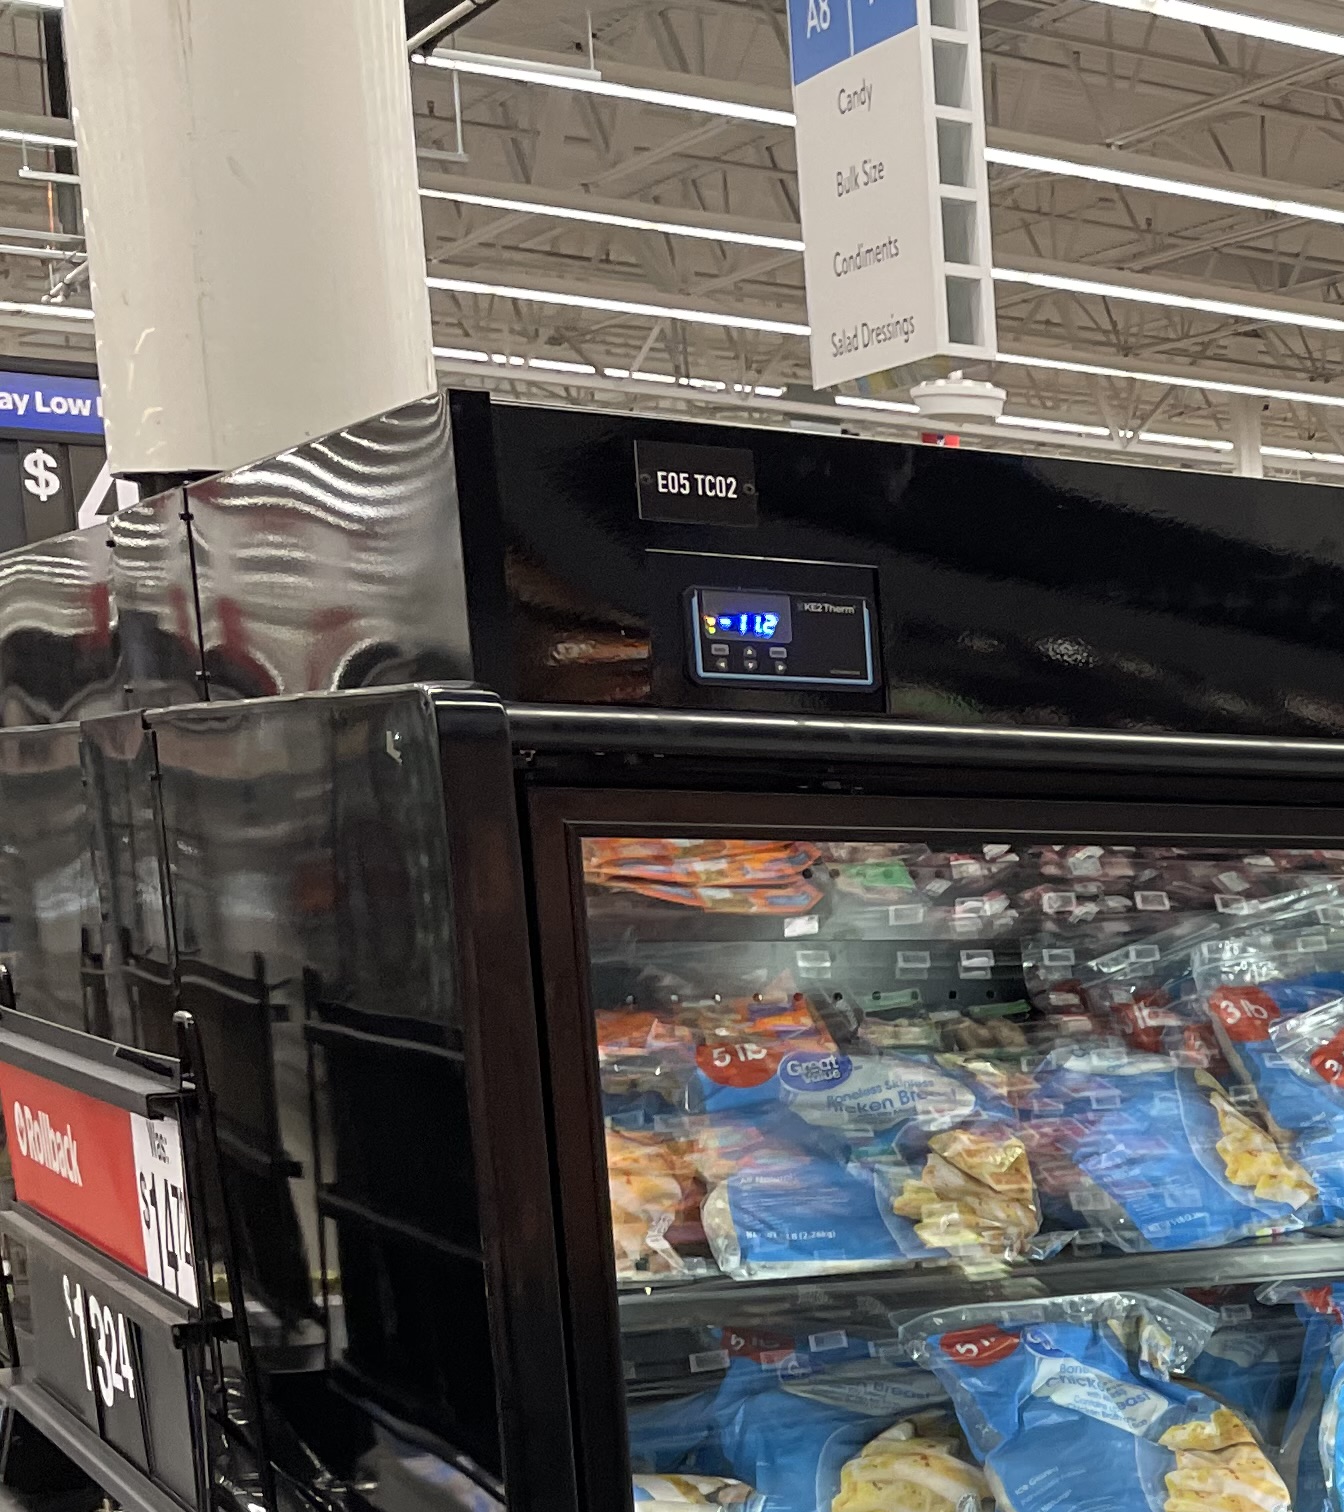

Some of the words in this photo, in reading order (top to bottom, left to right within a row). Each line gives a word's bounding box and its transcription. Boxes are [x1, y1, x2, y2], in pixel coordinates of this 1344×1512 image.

[837, 79, 873, 115] Candy
[836, 164, 860, 198] Bulk
[861, 160, 885, 186] Size
[833, 236, 900, 278] Condiments
[831, 327, 859, 359] Salad
[862, 313, 915, 351] Dressings
[34, 391, 92, 417] Low
[656, 470, 690, 496] E05
[694, 474, 738, 499] TC02
[712, 1048, 731, 1067] 5
[786, 1055, 840, 1077] Great
[802, 1068, 842, 1083] Value
[24, 1105, 84, 1187] Rollback
